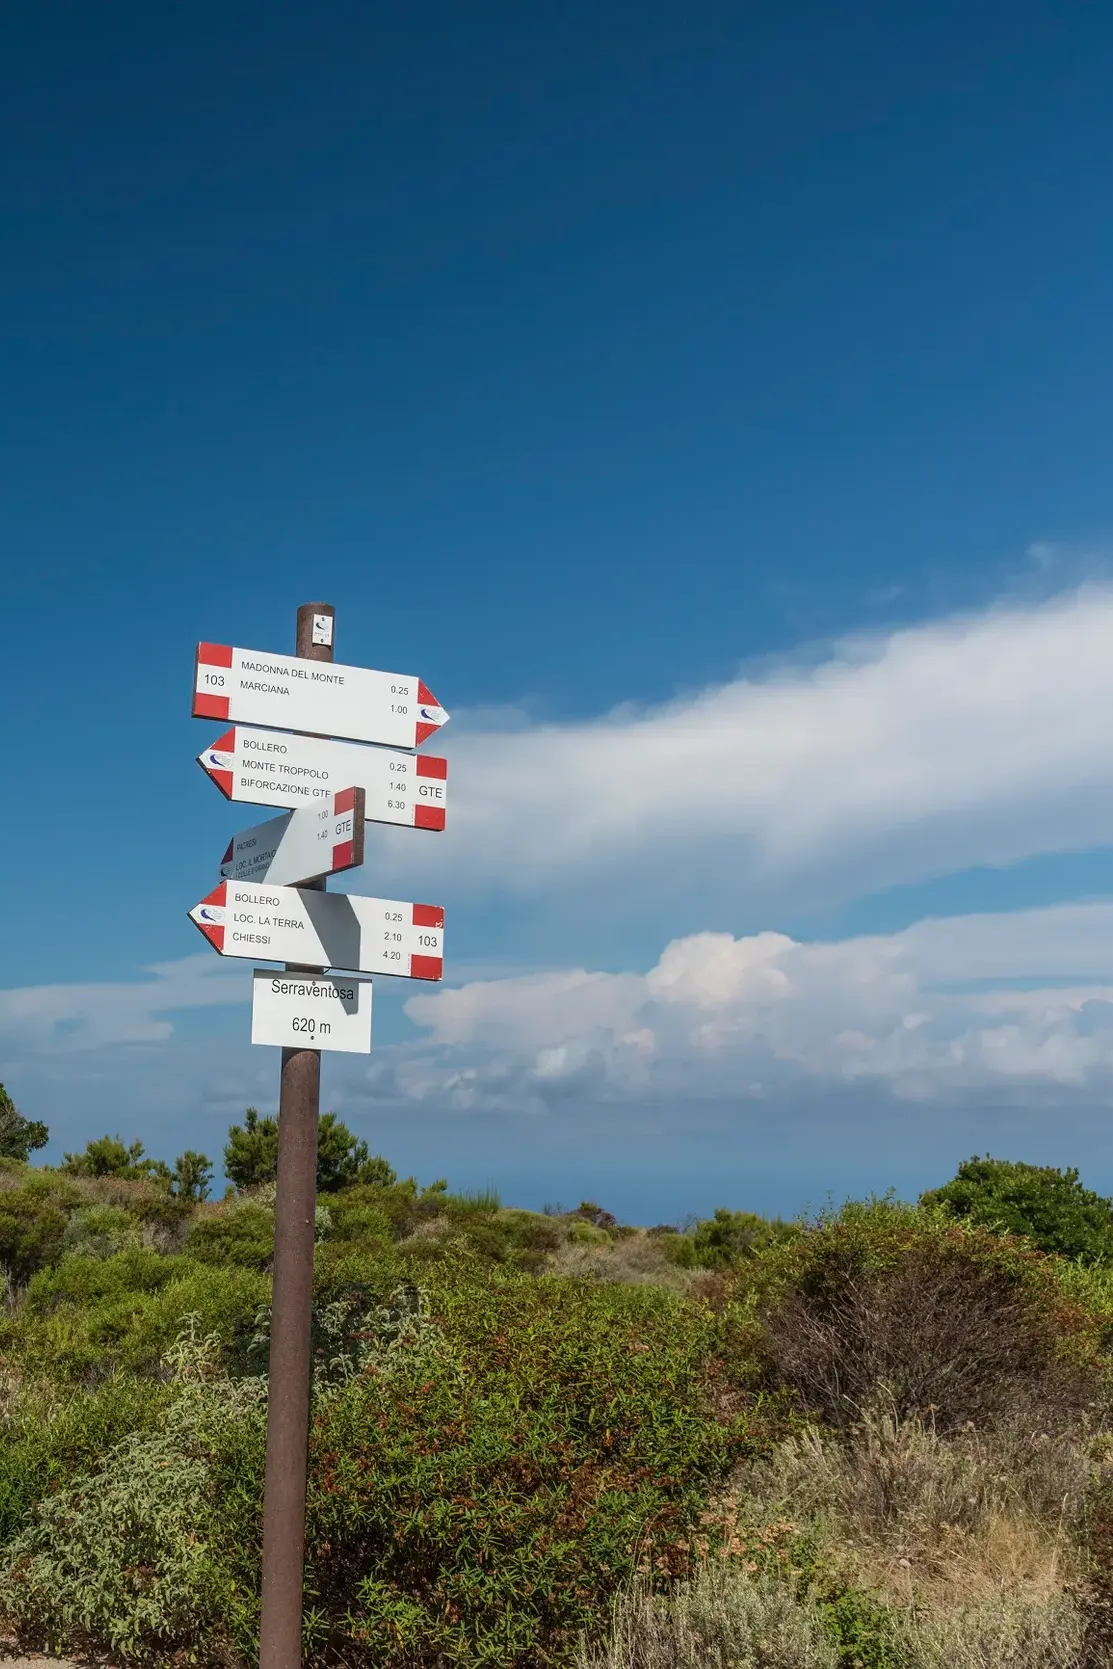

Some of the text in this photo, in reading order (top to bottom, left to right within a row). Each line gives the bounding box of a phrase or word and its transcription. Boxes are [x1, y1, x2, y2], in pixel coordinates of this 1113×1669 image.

[241, 661, 345, 685] MADONNA DEL MONTE
[204, 674, 225, 687] 103
[240, 680, 290, 696] MARCIANA
[390, 686, 409, 696] 0.25
[390, 704, 408, 714] 1.00
[243, 740, 287, 754] BOLLERO
[242, 760, 329, 780] MONTE TROPPOLO
[389, 763, 407, 773] 0.25
[241, 778, 310, 796] BIFORCAZIONE
[389, 782, 406, 792] 1.40
[419, 785, 443, 798] GTE
[388, 800, 405, 810] 6.30
[335, 819, 352, 835] GTE
[235, 893, 280, 906] BOLLERO
[233, 913, 305, 929] LOC. LA TERRA
[385, 912, 403, 922] 0.25
[233, 933, 271, 945] CHIESSI
[384, 932, 402, 942] 2.10
[418, 935, 438, 947] 103
[383, 951, 401, 961] 4.20
[271, 979, 354, 1000] Serraventosa
[292, 1018, 331, 1033] 620 m
